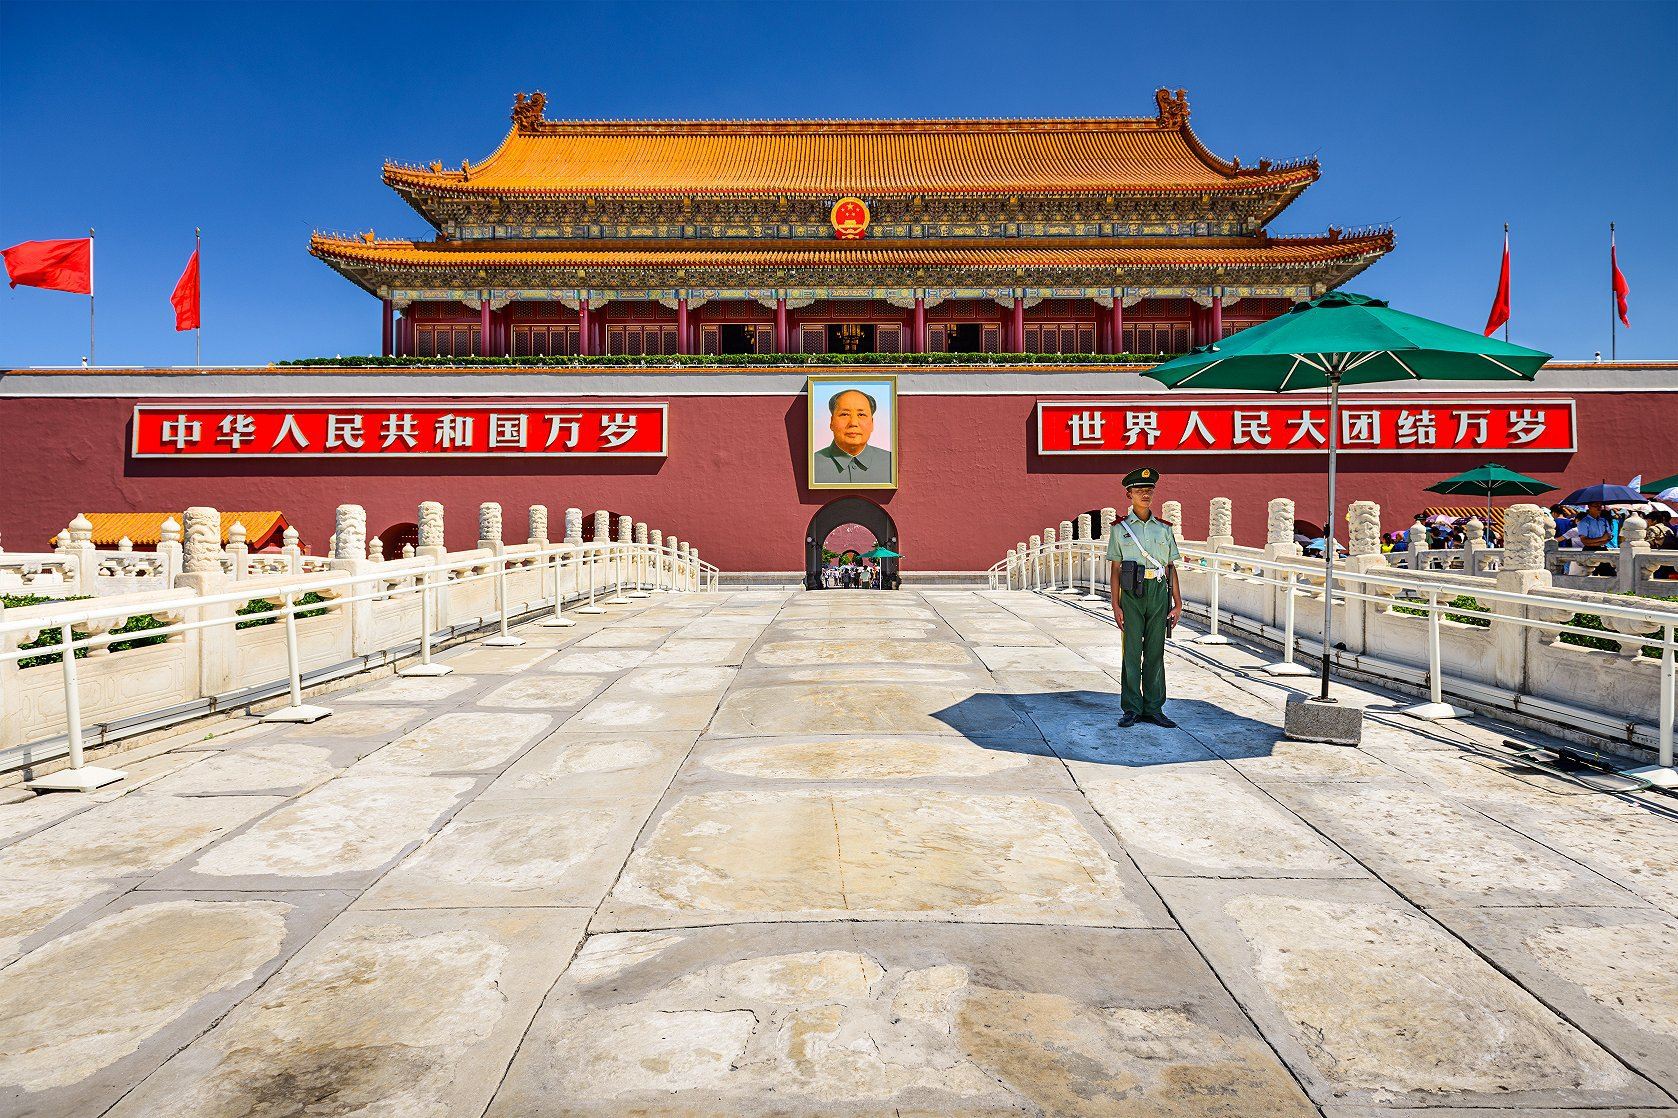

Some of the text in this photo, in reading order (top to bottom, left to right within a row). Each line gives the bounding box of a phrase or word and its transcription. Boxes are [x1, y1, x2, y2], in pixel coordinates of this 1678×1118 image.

[161, 413, 638, 449] 中华人民共和国万岁
[1067, 409, 1547, 446] 世界人民大团结万岁
